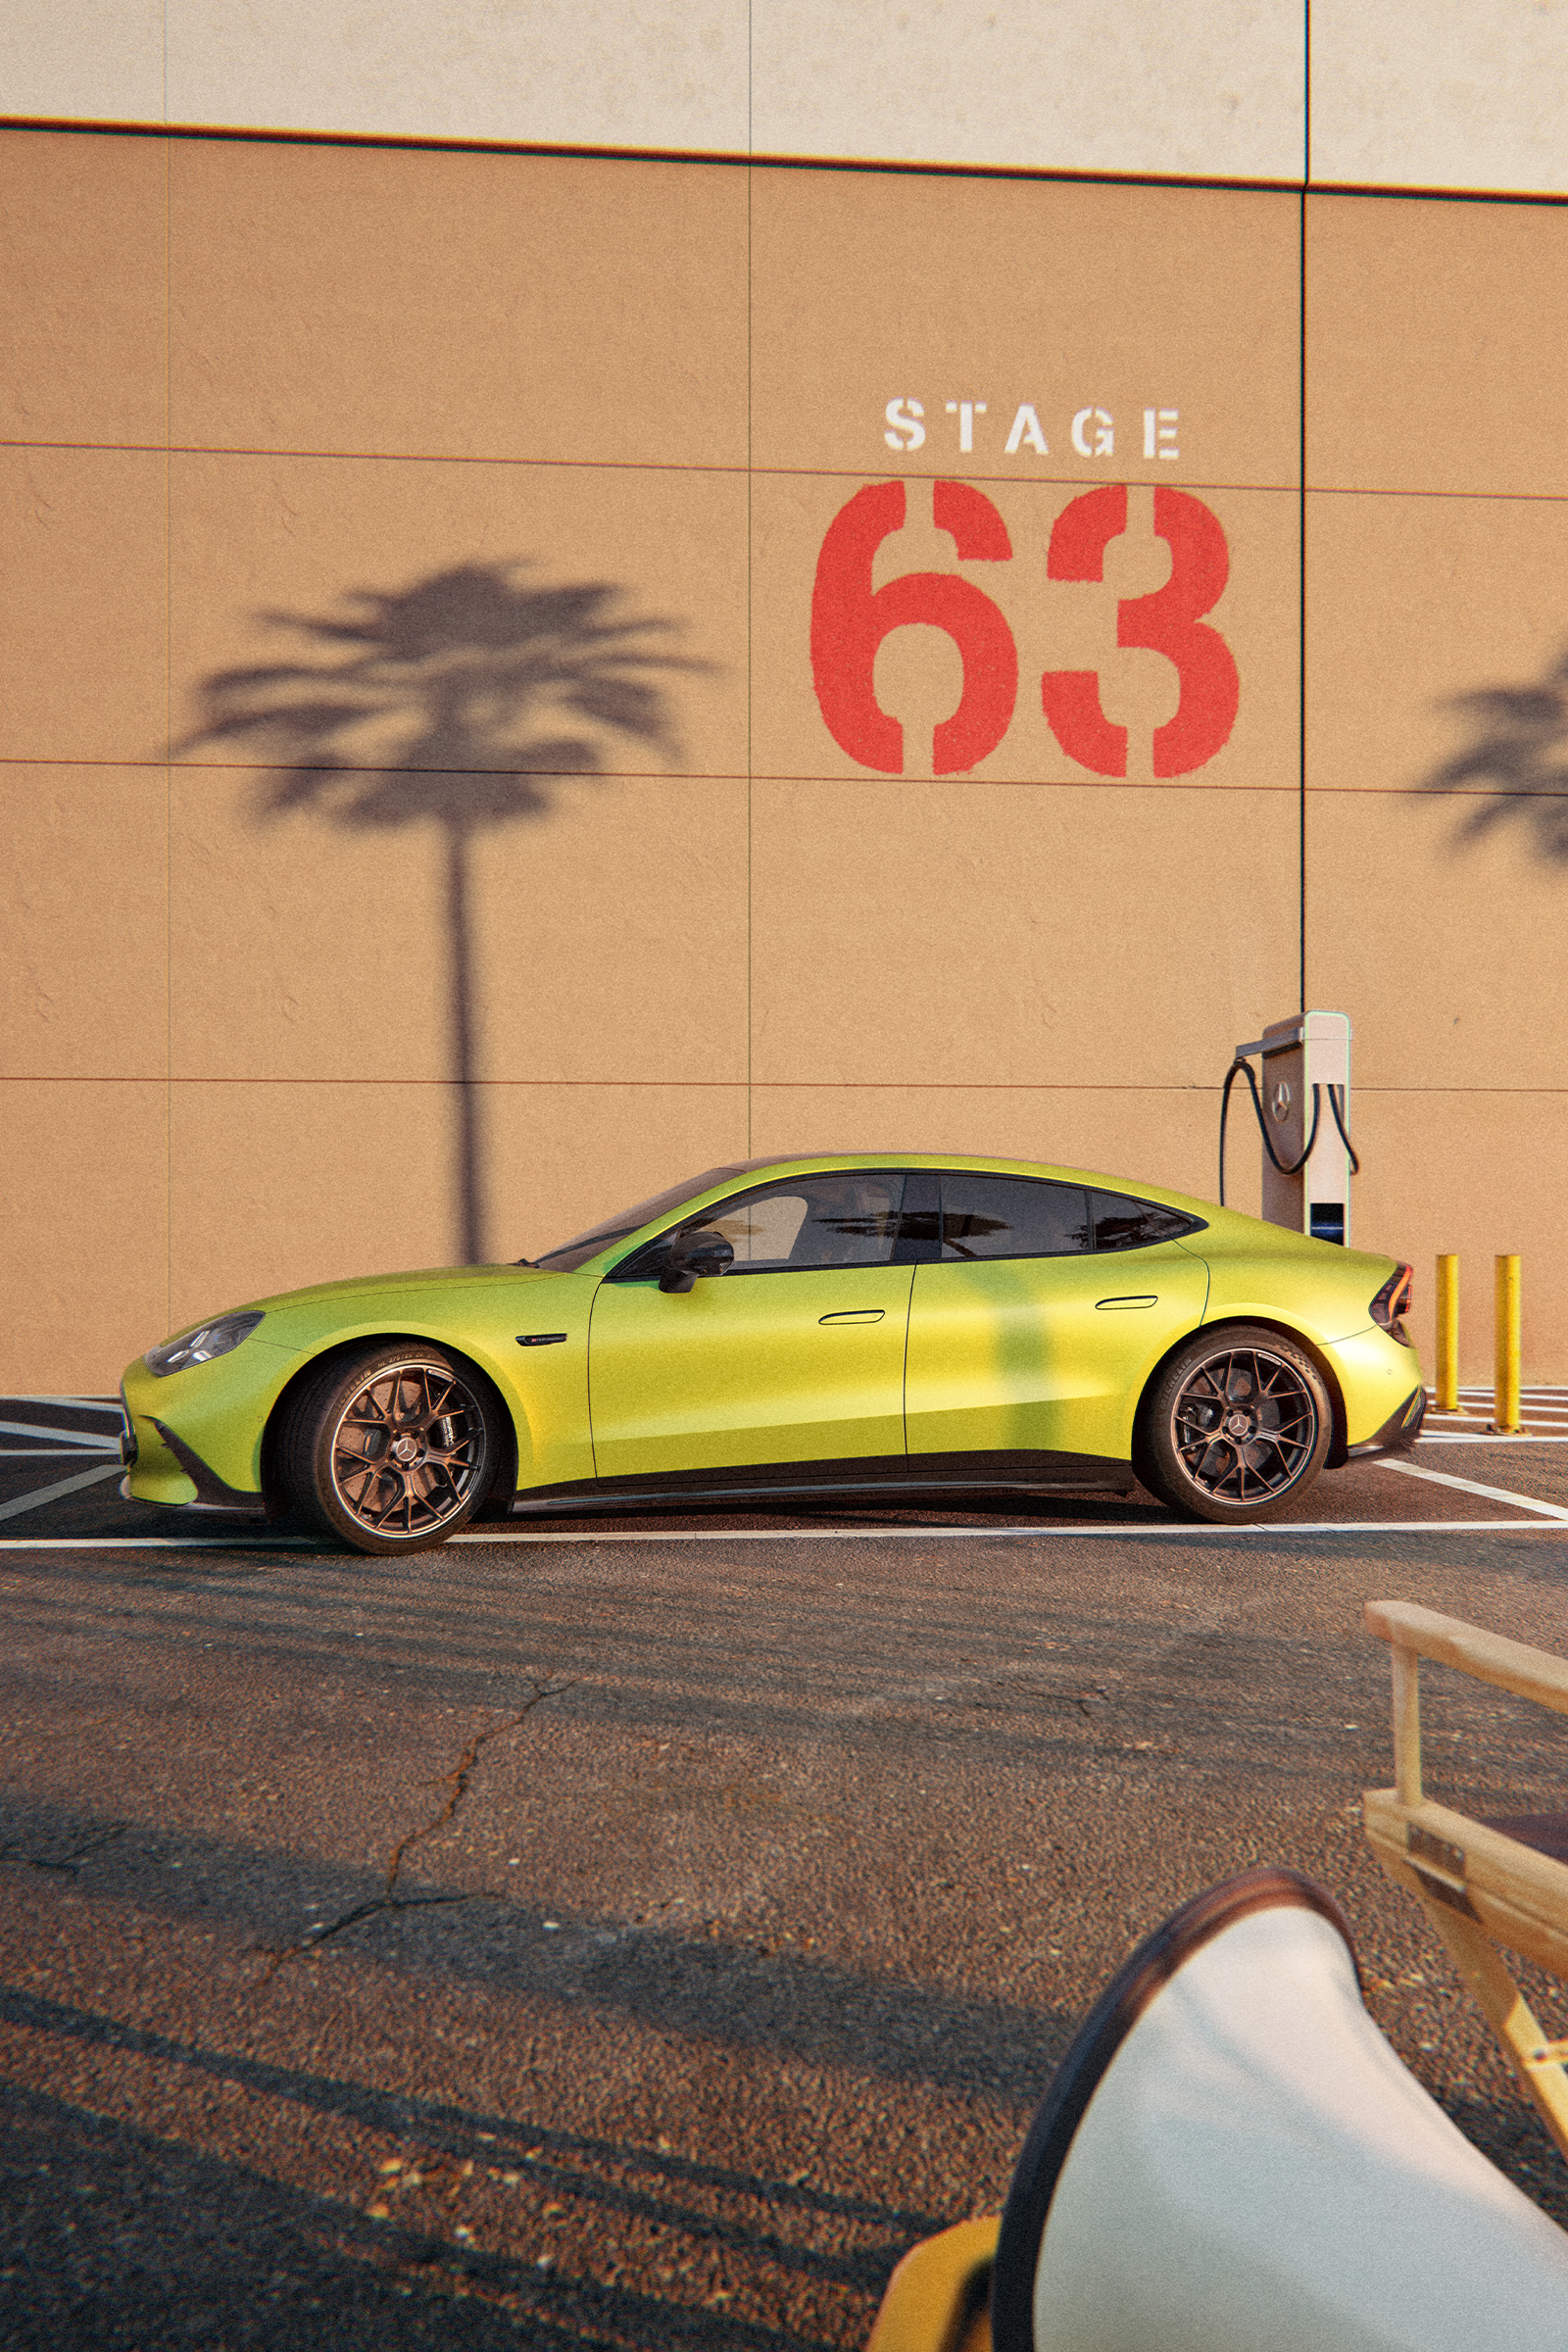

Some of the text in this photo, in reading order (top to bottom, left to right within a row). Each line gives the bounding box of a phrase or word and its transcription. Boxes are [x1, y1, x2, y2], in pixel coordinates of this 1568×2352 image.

[884, 396, 1180, 460] STAGE
[809, 479, 1240, 779] 63
[1160, 1356, 1193, 1411] MICHELIN
